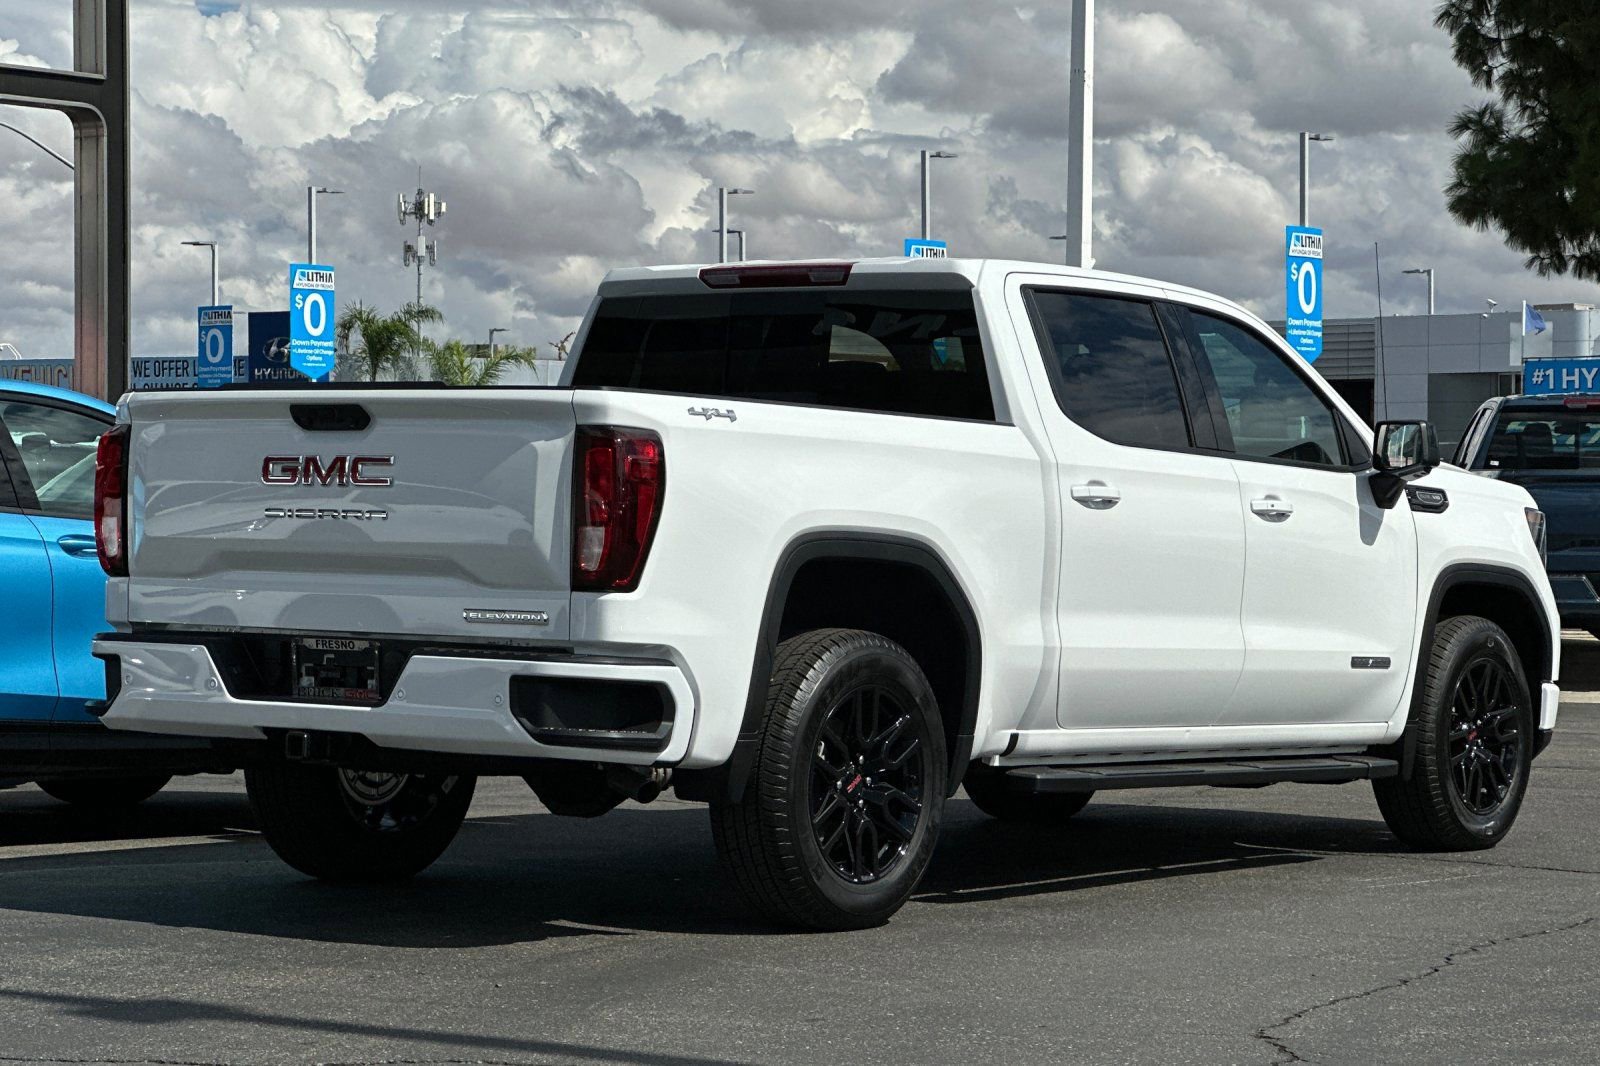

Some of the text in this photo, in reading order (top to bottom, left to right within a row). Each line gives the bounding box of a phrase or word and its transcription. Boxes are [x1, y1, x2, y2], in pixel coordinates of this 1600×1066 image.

[306, 272, 333, 283] LITHIA
[207, 311, 232, 320] LITHIA
[132, 360, 150, 378] WE
[153, 359, 190, 378] OFFER
[1532, 368, 1598, 389] #1 HY
[261, 456, 394, 486] GMC
[264, 508, 389, 521] SIERRA
[469, 612, 540, 620] ELEVATION
[315, 640, 355, 650] FRESNO
